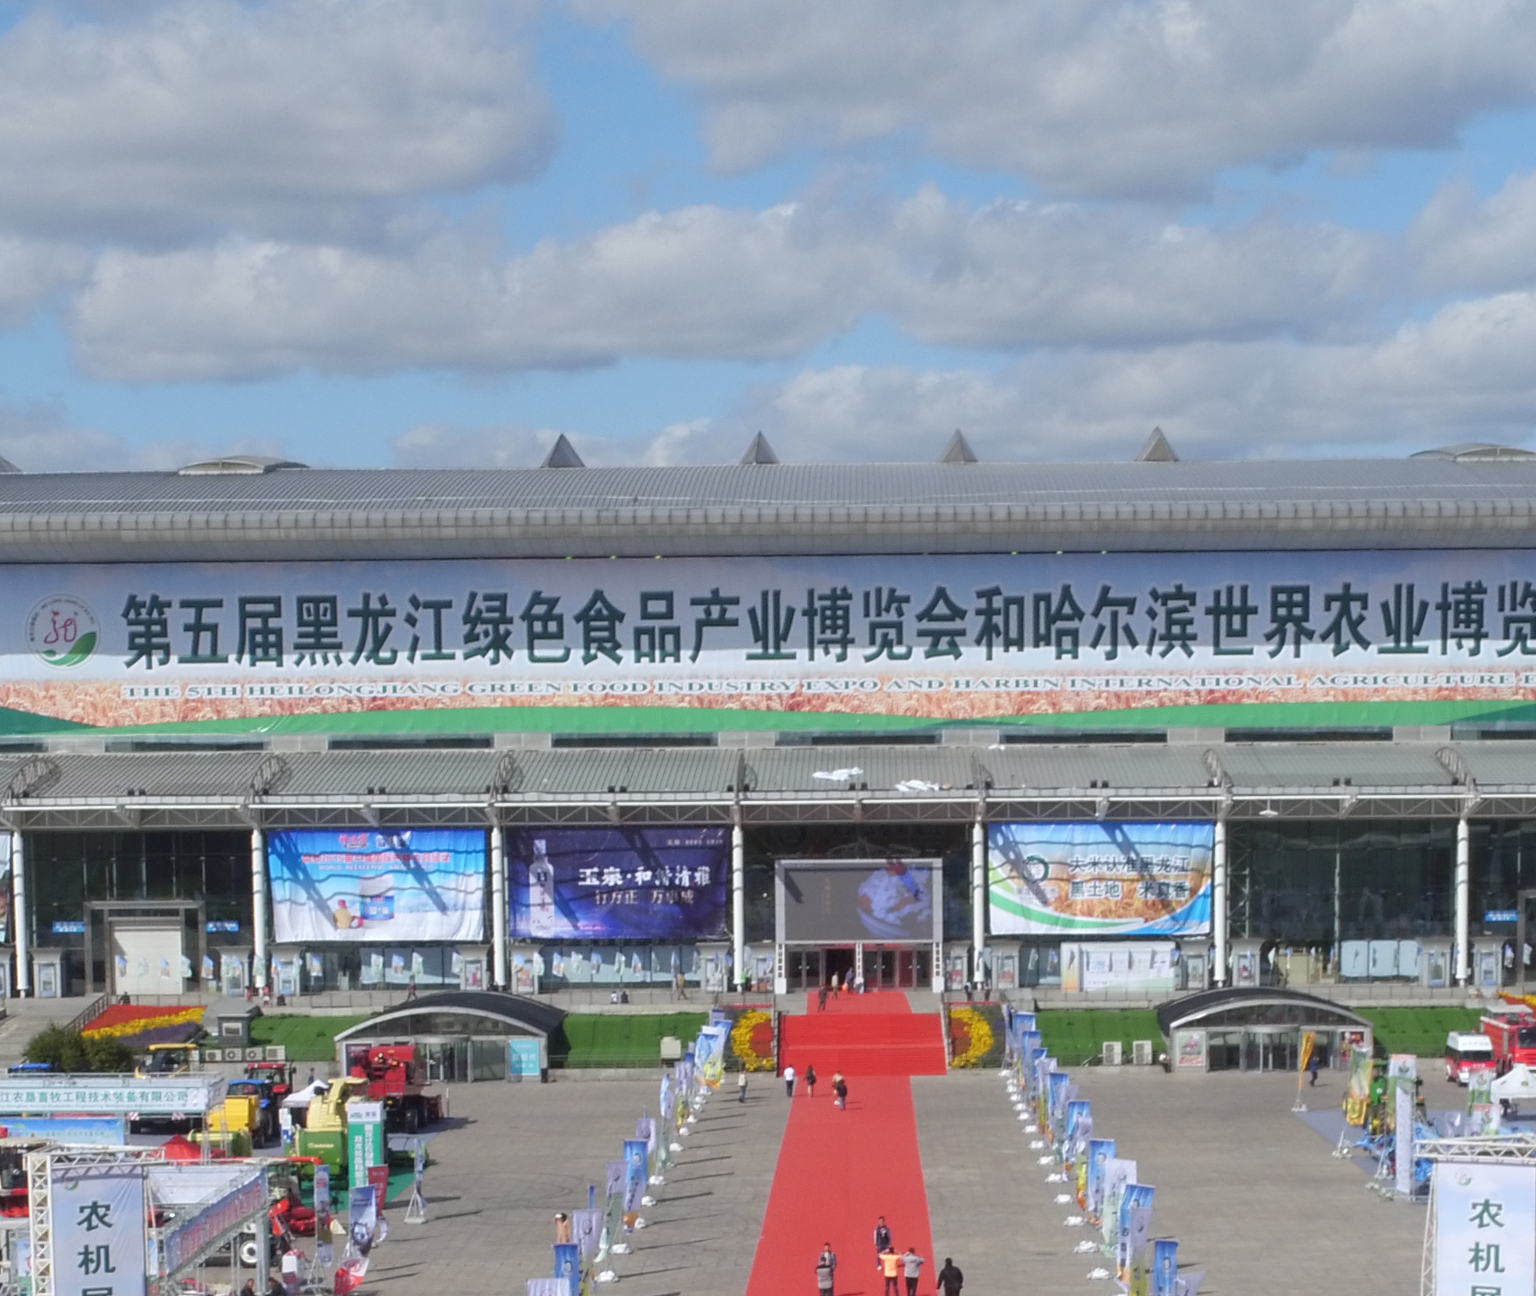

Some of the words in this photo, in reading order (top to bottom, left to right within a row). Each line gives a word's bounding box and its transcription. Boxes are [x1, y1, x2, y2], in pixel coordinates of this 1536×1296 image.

[126, 687, 178, 697] THE
[187, 687, 238, 697] 5TH
[248, 683, 458, 697] HEILONGJIANG
[467, 682, 559, 694] GREEN
[573, 681, 647, 693] FOOD
[656, 680, 796, 693] INDUSTRY
[805, 679, 878, 691] EXPO
[886, 678, 945, 690] AND
[954, 678, 1059, 690] HARBIN
[1070, 676, 1298, 690] INTERNATIONAL
[1310, 674, 1514, 688] AGRICULTURE
[1070, 856, 1190, 874] 大米认准黑龙江
[1069, 882, 1121, 899] 黑土地
[1139, 882, 1190, 899] 米真香
